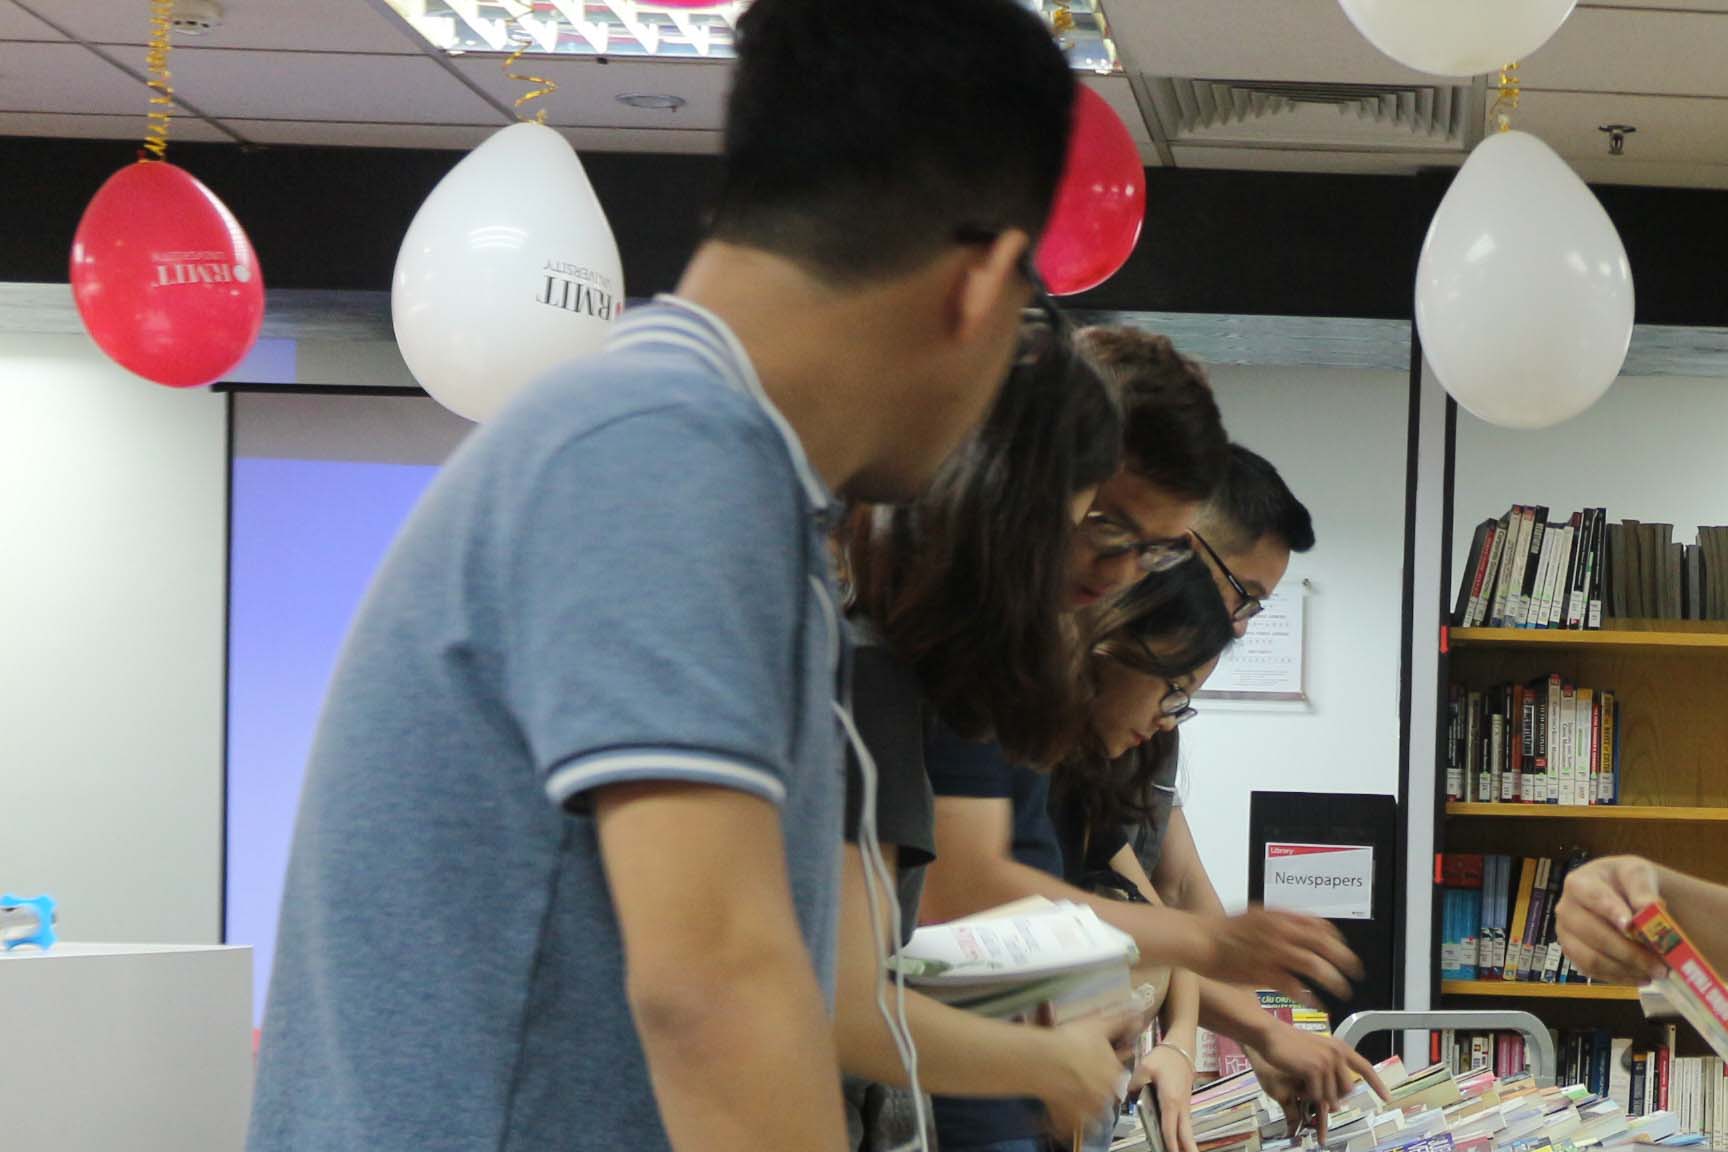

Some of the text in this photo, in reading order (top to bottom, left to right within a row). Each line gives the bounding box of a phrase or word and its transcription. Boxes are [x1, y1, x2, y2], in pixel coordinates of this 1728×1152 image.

[151, 262, 232, 287] RMIT
[536, 276, 612, 321] RMIT
[1270, 847, 1296, 856] Library
[1275, 871, 1363, 889] Newspapers
